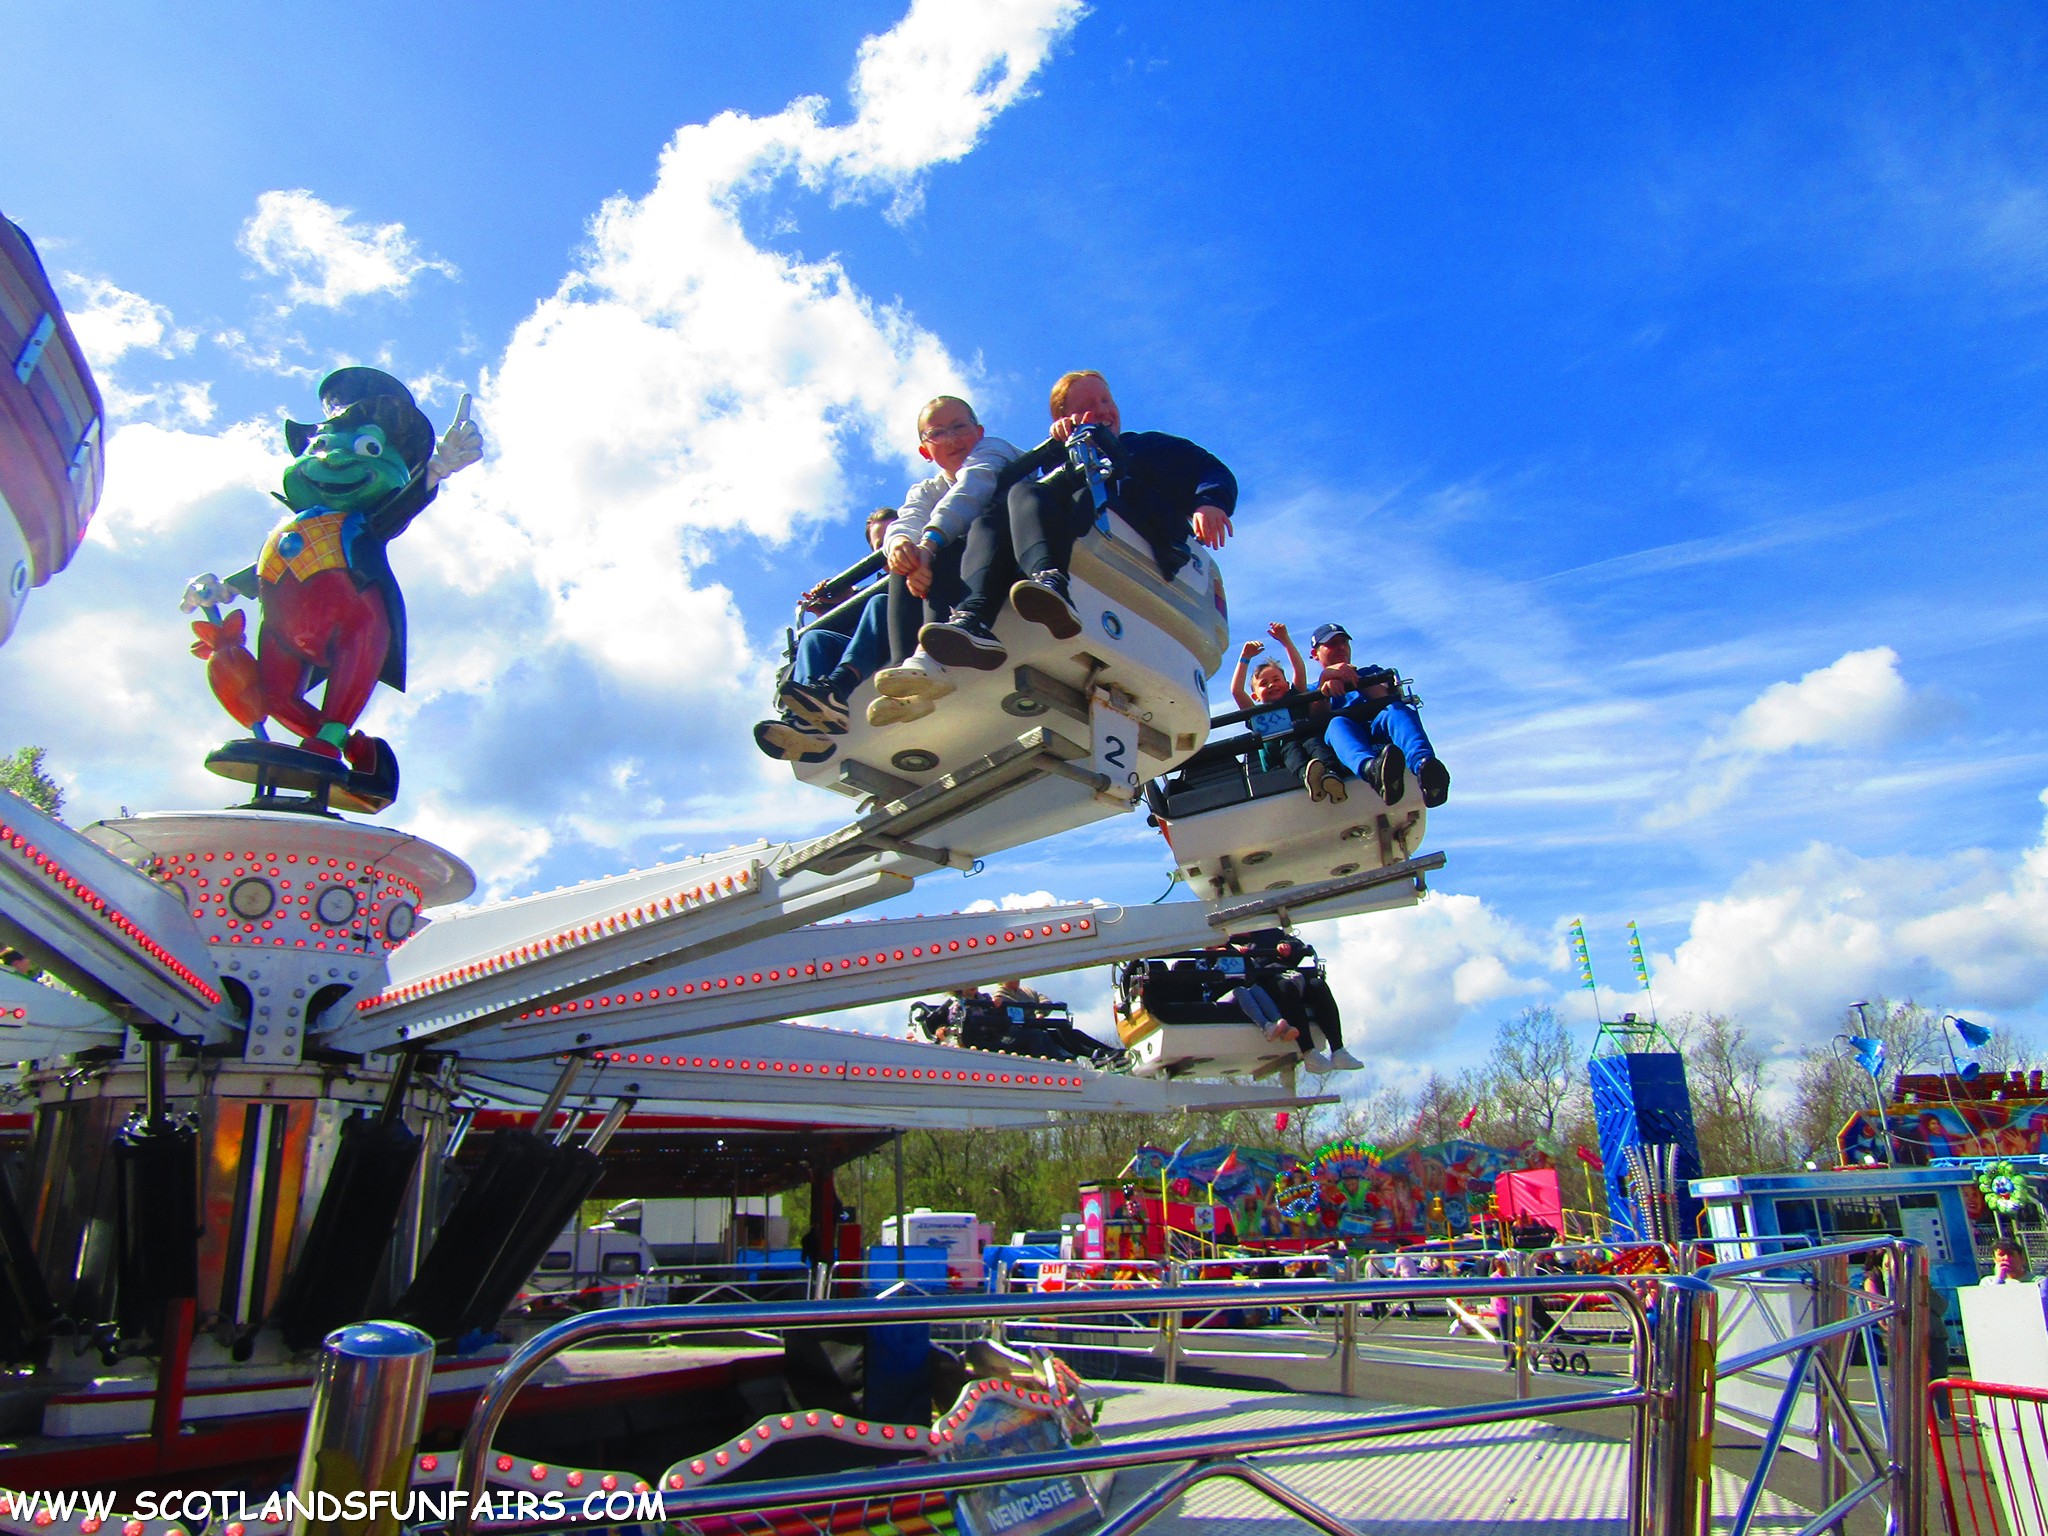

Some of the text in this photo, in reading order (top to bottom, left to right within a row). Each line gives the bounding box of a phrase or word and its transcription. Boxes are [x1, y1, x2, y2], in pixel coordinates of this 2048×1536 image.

[1104, 735, 1126, 769] 2
[1042, 1264, 1063, 1274] EXIT
[986, 1480, 1077, 1532] NEWCASTLE
